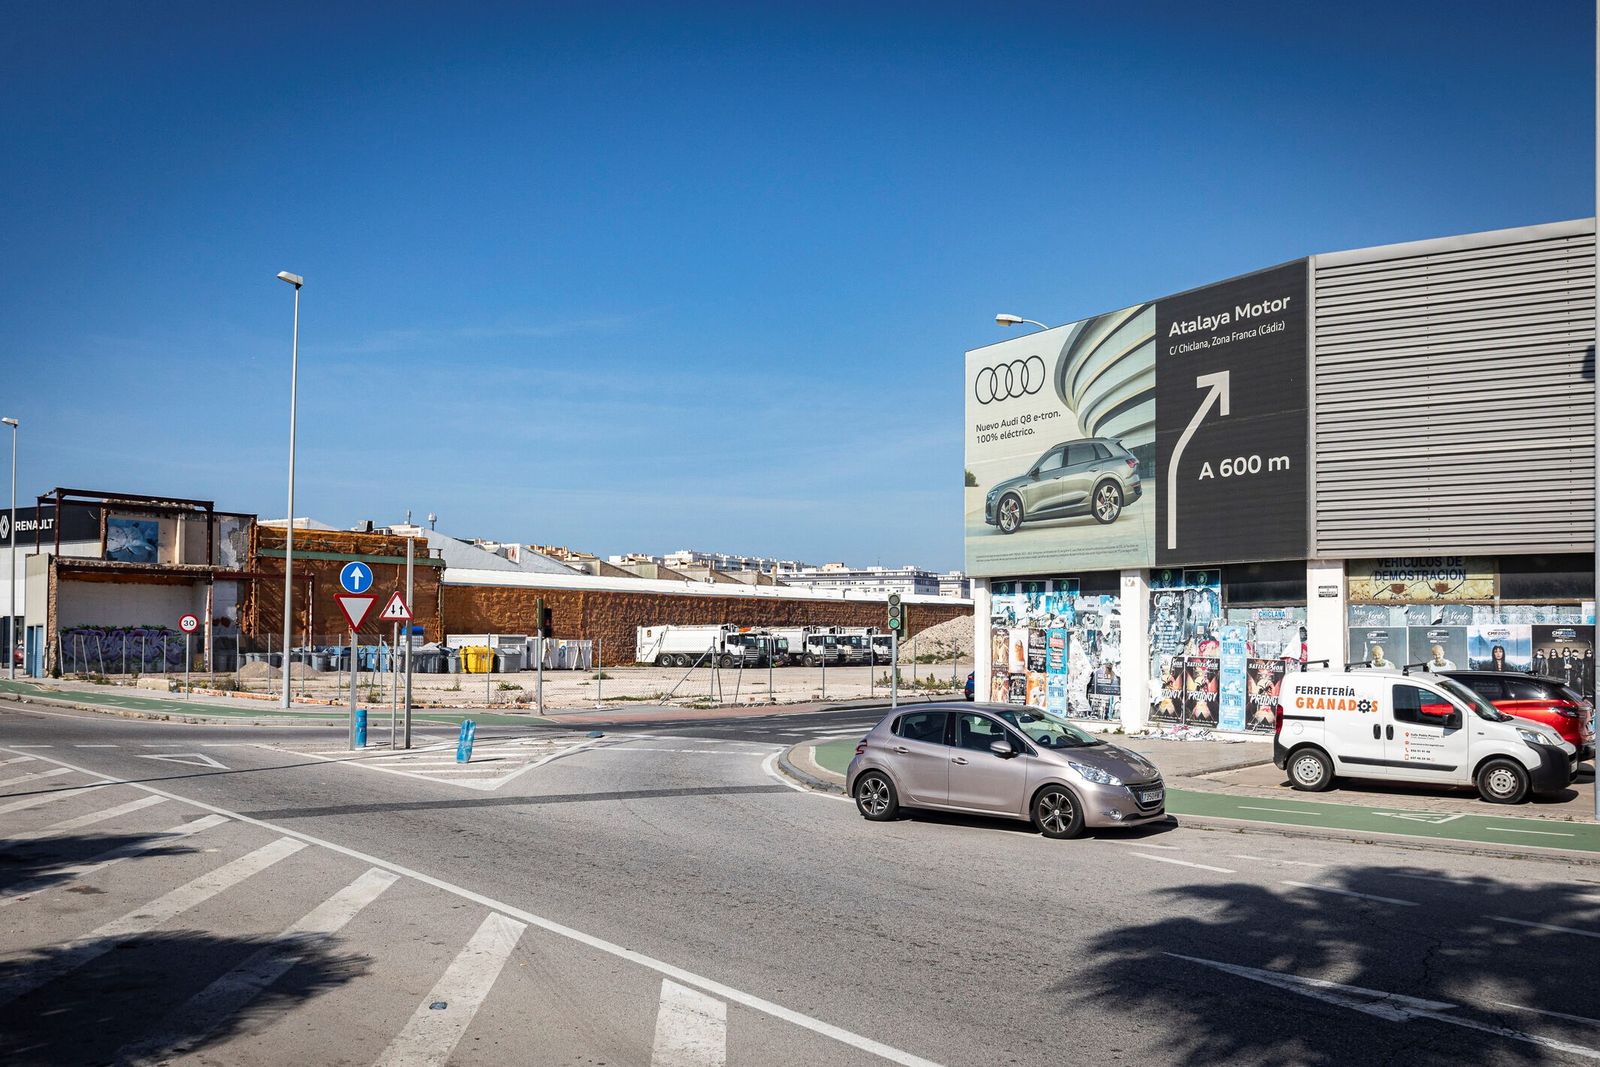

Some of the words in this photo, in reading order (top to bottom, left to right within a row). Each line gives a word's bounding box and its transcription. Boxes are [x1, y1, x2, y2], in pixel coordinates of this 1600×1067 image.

[1168, 312, 1231, 338] Atalaya
[1235, 296, 1291, 321] Motor
[1169, 345, 1178, 356] C/
[1178, 341, 1211, 354] Chiclana,
[1211, 335, 1231, 347] Zona
[1231, 329, 1257, 342] Franca
[1258, 320, 1286, 336] (Cádiz)
[976, 422, 1000, 433] Nuevo
[1000, 417, 1019, 428] Audi
[1020, 414, 1032, 425] Q8
[1033, 410, 1061, 422] e-tron.
[977, 432, 999, 444] 100%
[1000, 428, 1035, 440] eléctrico.
[1198, 461, 1215, 481] A
[1219, 454, 1262, 478] 600
[1268, 455, 1290, 472] m
[15, 518, 54, 532] RENAULT
[1446, 556, 1463, 567] DE
[1258, 610, 1286, 618] CHICLANA
[183, 619, 195, 627] 30
[1295, 685, 1356, 697] FERRETERÍA
[1295, 697, 1378, 714] GRANADOS
